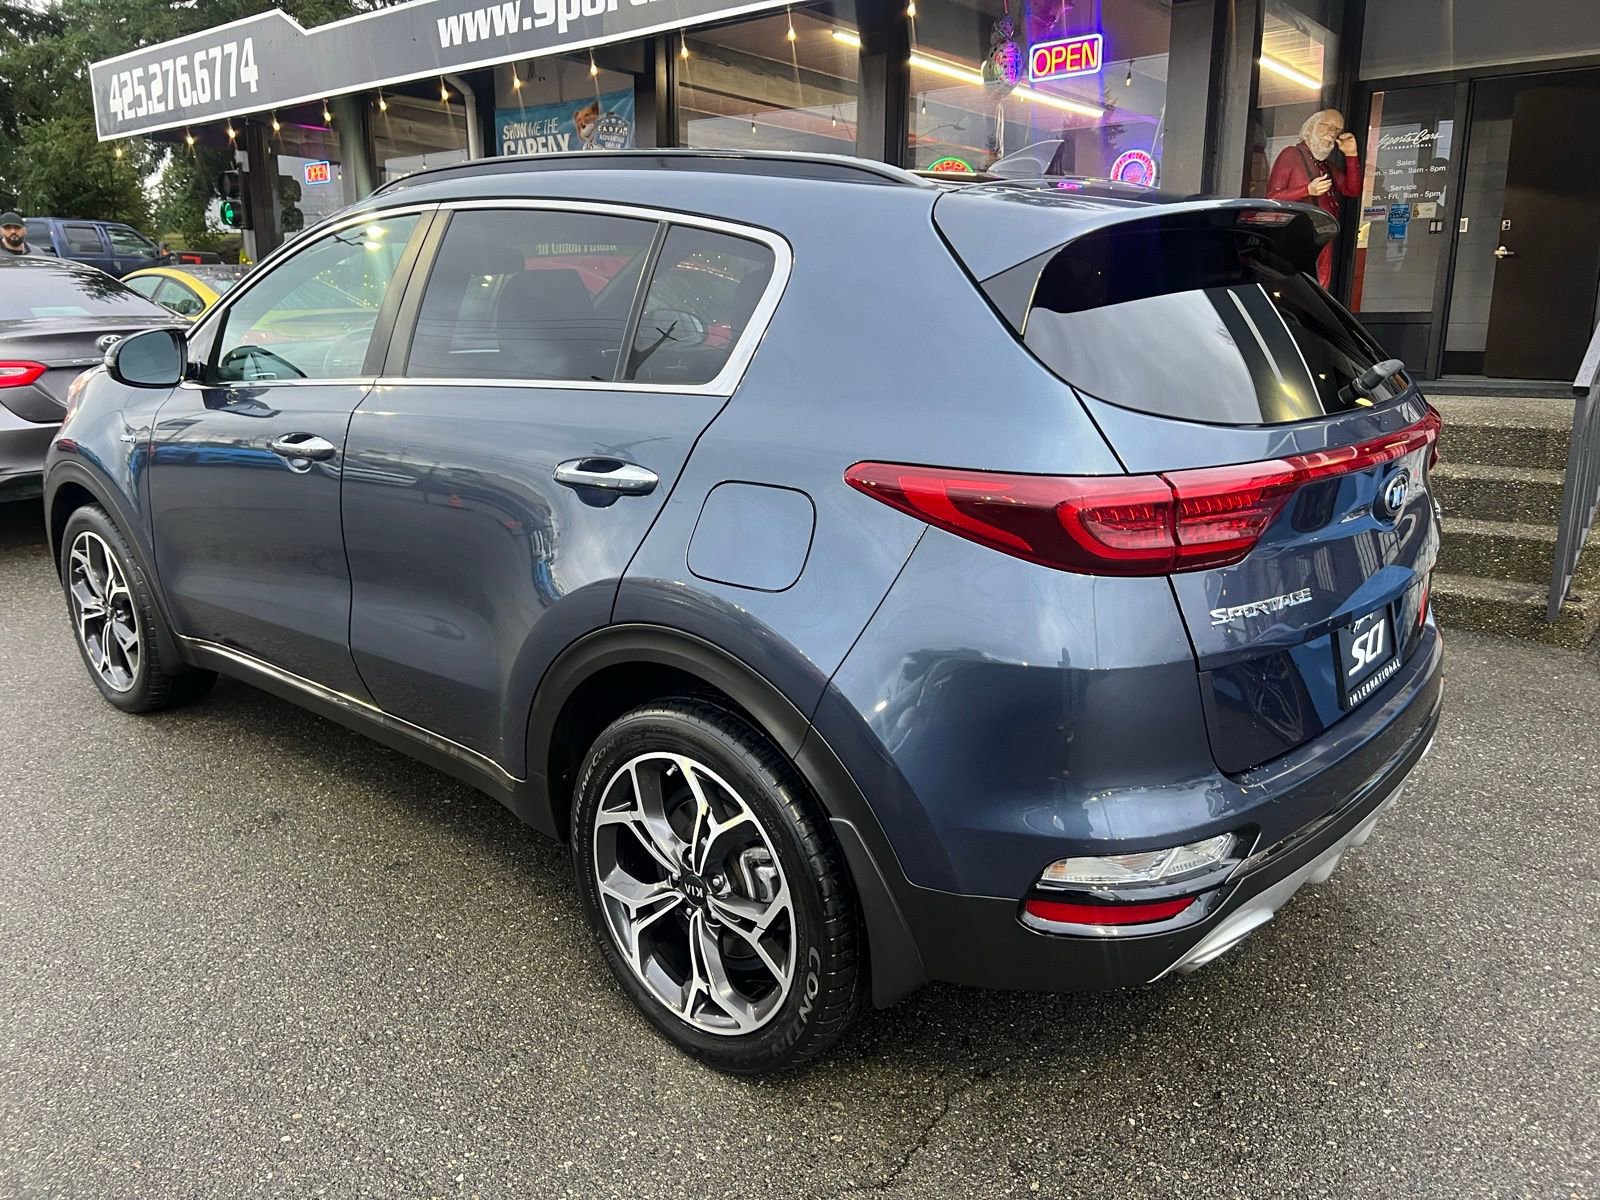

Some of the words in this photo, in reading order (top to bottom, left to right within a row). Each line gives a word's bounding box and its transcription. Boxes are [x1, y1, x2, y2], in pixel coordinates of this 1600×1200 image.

[1033, 39, 1098, 77] OPEN
[109, 37, 259, 122] 425.276.6774
[503, 122, 528, 140] SHOW
[528, 120, 543, 137] ME
[544, 117, 559, 135] THE
[1377, 132, 1417, 150] Sports
[1413, 129, 1444, 145] Cars
[1396, 159, 1416, 167] Sales
[1429, 165, 1447, 173] 8pm
[307, 164, 329, 182] OPEN
[1390, 184, 1417, 192] Service
[1403, 191, 1419, 199] 9am
[1424, 190, 1441, 198] 5pm
[1210, 587, 1313, 626] SPORTAGE
[1349, 658, 1401, 707] INTERNATIONAL
[684, 882, 704, 898] KIA
